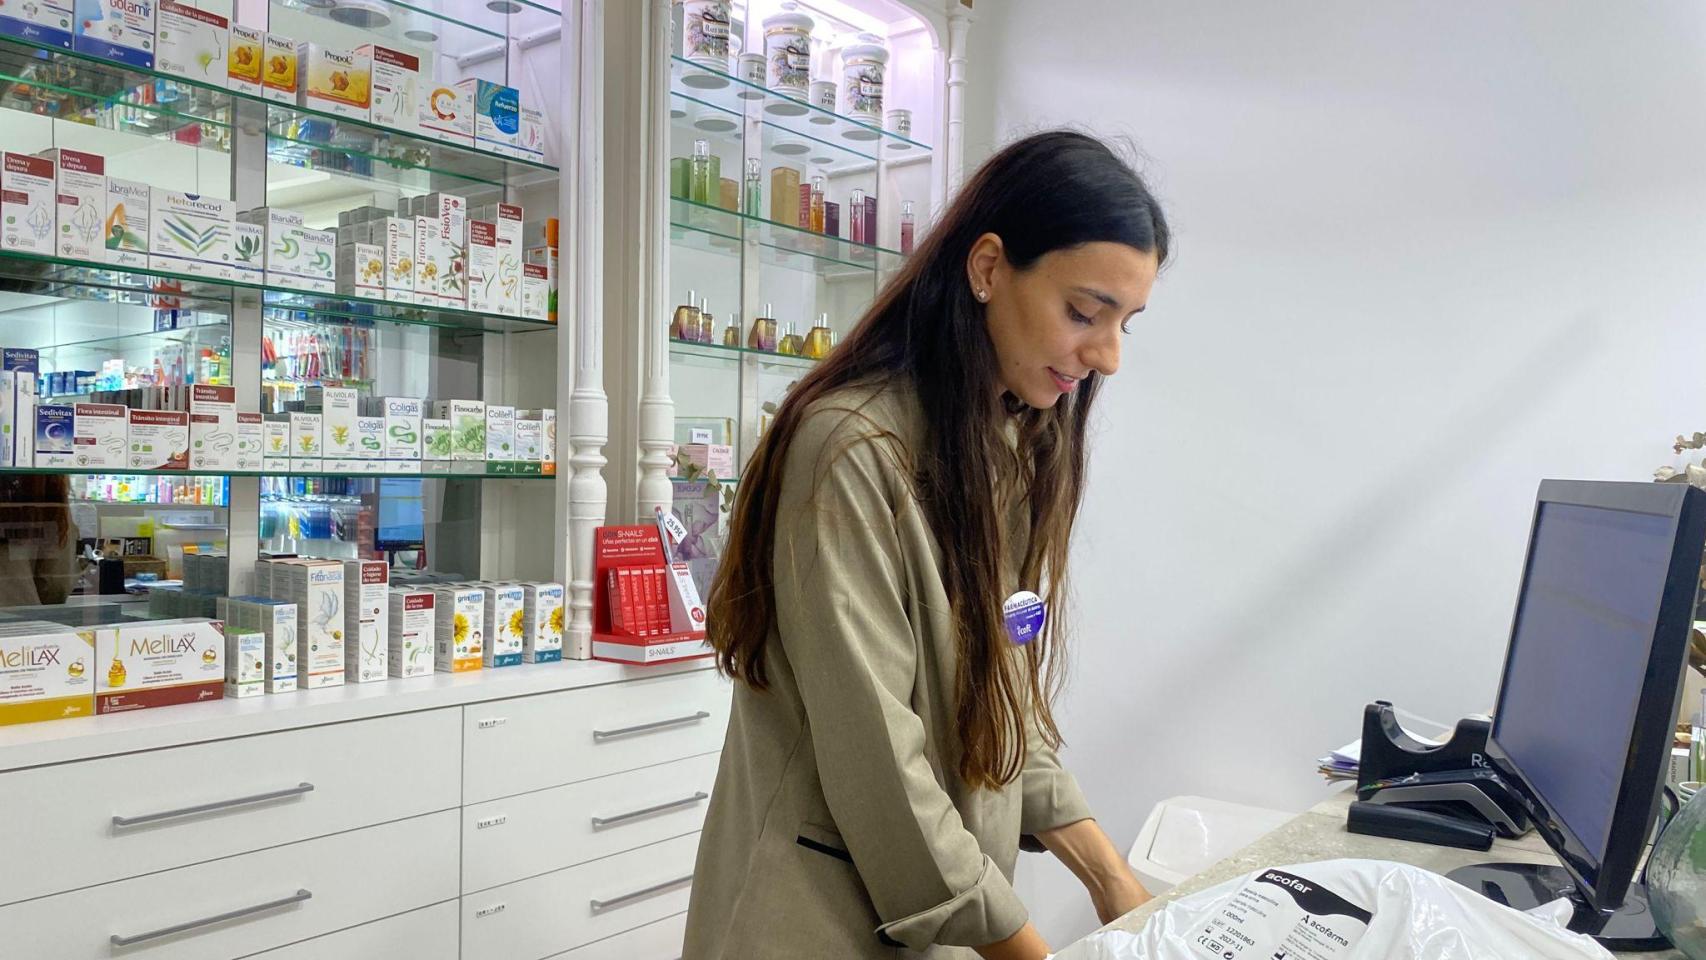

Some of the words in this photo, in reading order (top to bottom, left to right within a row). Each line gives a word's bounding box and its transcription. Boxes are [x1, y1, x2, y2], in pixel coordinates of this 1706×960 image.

[5, 351, 37, 360] Sedivitax
[39, 408, 72, 417] Sedivitax
[0, 646, 60, 668] eliLAX
[648, 647, 674, 657] SI-NAILS
[1265, 872, 1313, 894] acofar
[1222, 909, 1245, 923] 1.000ml
[1310, 920, 1349, 947] acofarma
[1219, 934, 1244, 951] 2027-11
